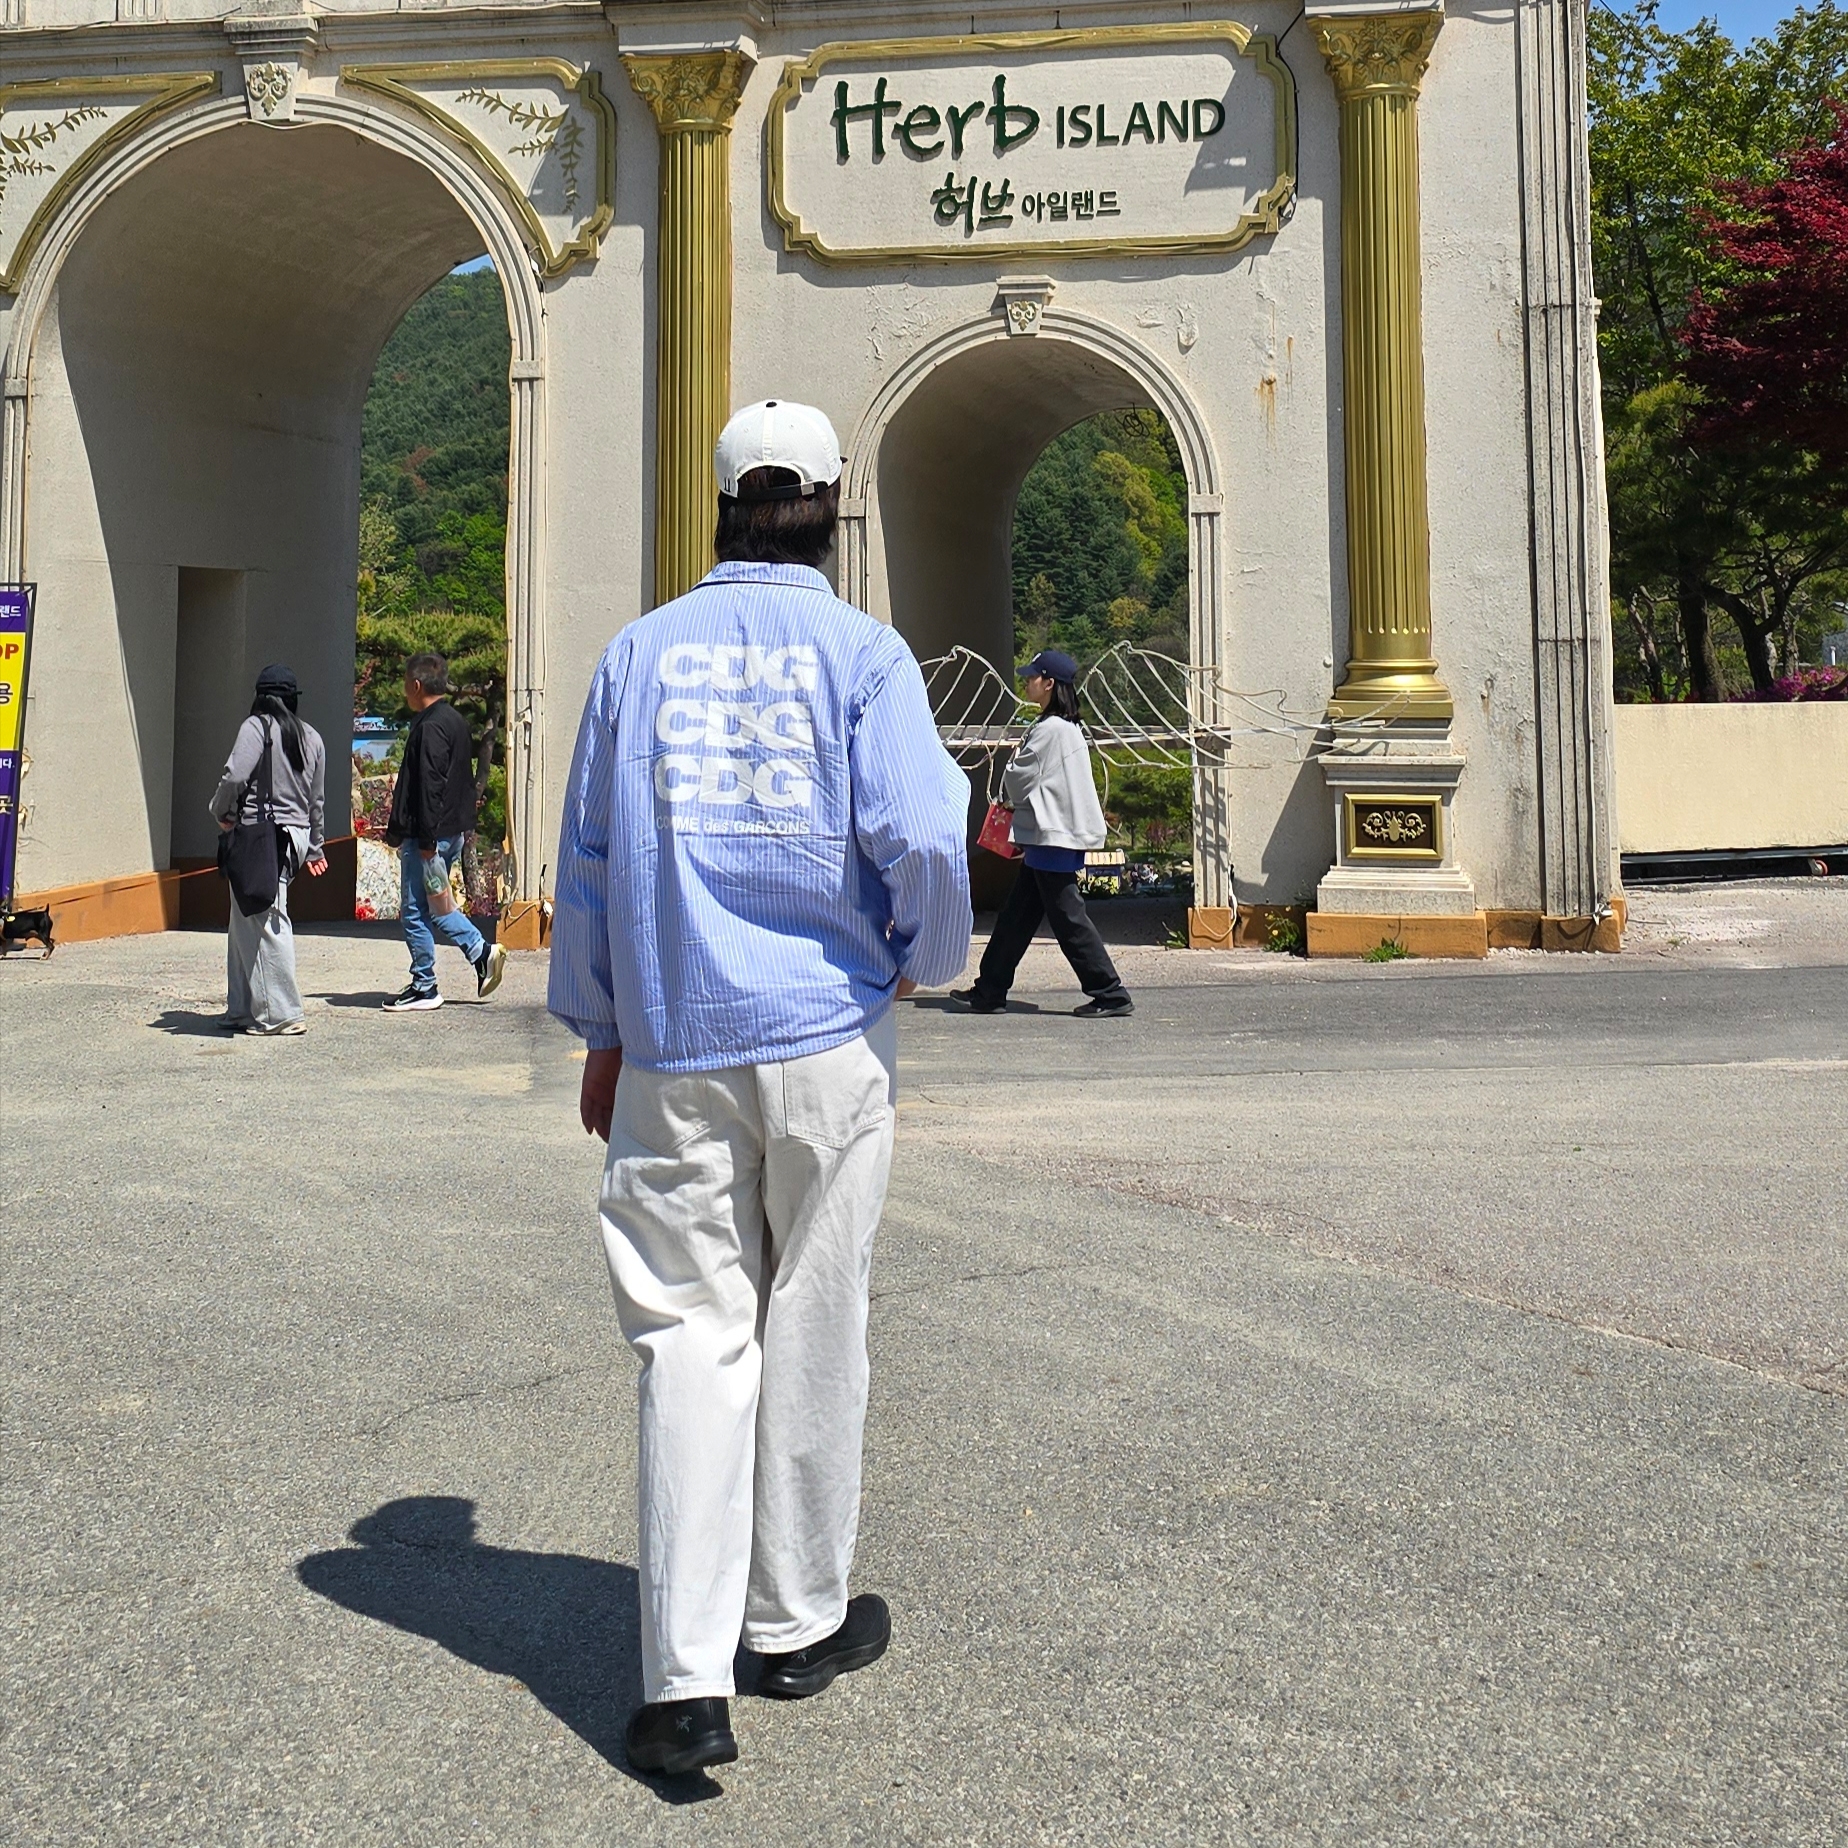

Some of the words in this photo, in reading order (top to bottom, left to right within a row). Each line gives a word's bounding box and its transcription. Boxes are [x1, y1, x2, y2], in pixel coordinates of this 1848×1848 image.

[830, 74, 1040, 164] Herb
[1056, 99, 1226, 148] ISLAND
[930, 172, 1015, 237] 허브
[1021, 190, 1122, 222] 아일랜드
[658, 643, 819, 691] CDG
[656, 699, 815, 753] CDG
[653, 754, 814, 808] CDG
[703, 817, 730, 833] des
